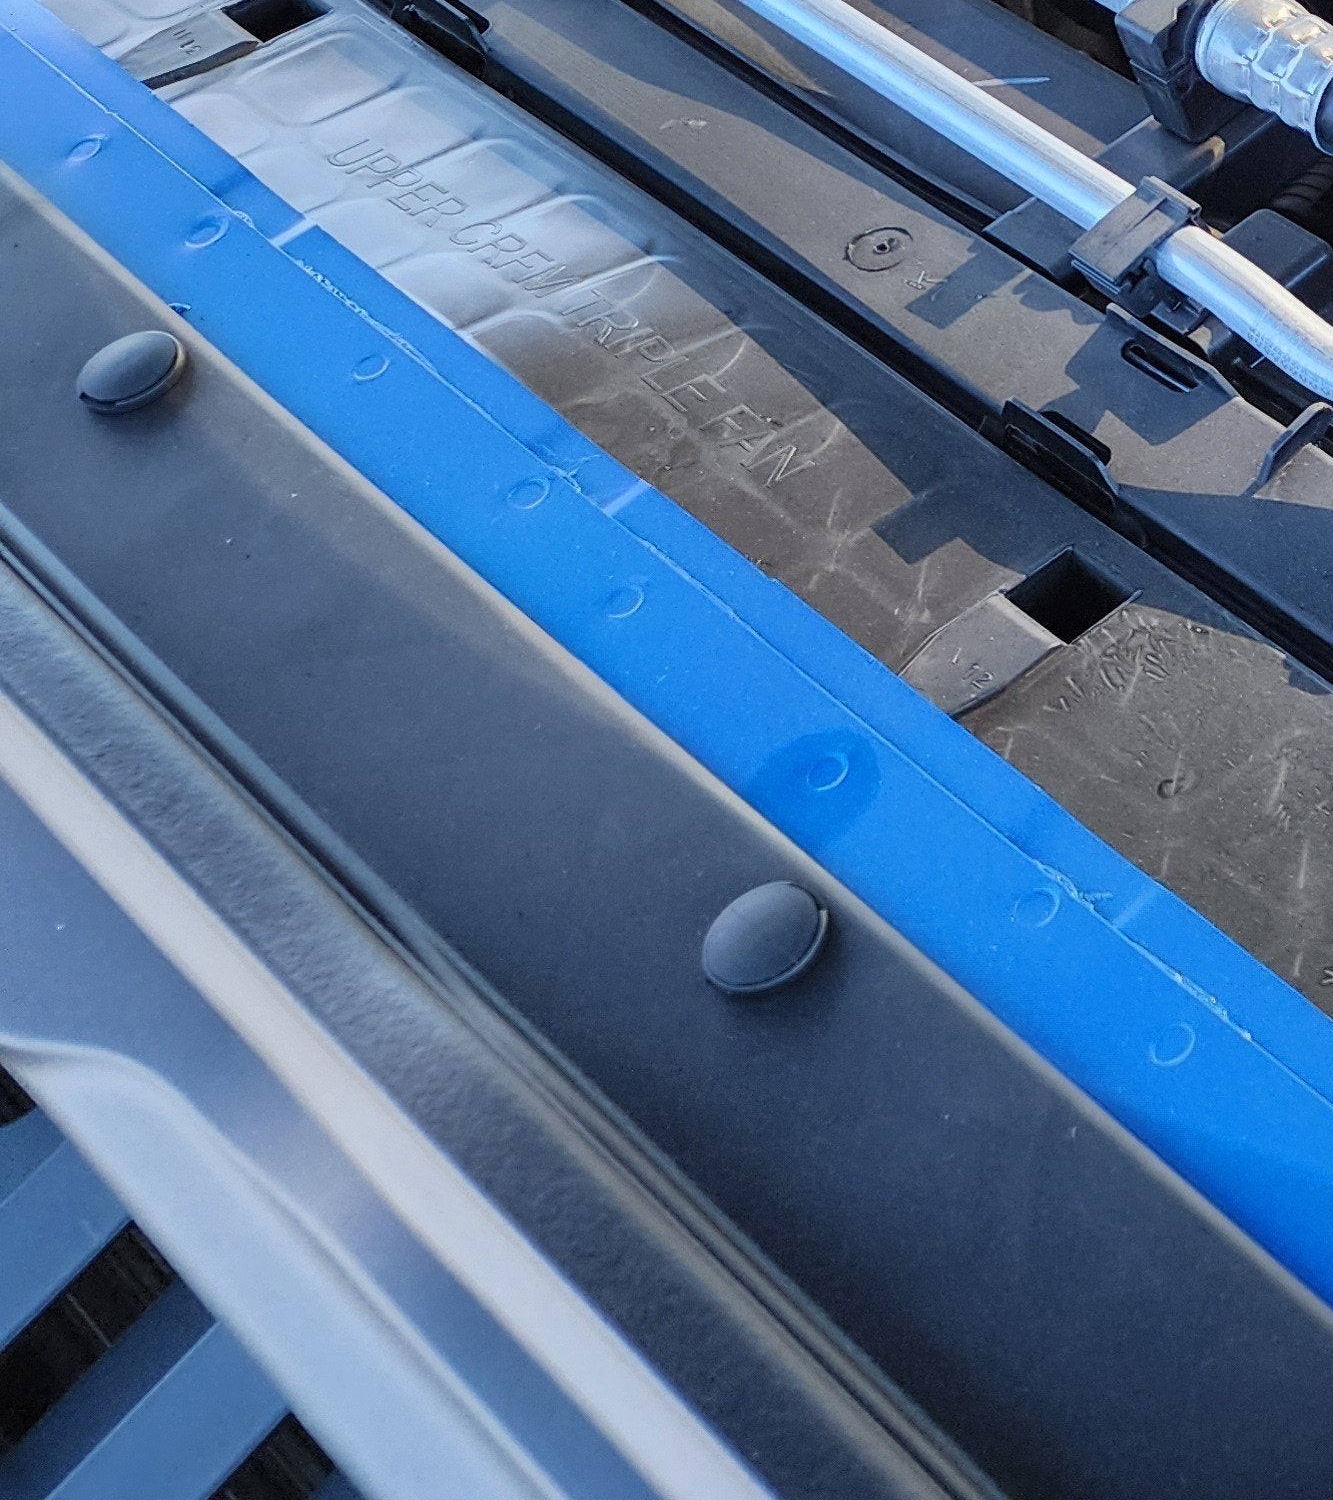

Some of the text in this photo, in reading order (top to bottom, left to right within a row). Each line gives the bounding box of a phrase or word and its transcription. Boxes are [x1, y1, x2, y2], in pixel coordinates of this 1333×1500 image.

[326, 137, 818, 488] UPPER CRFM TRIPLE FAN
